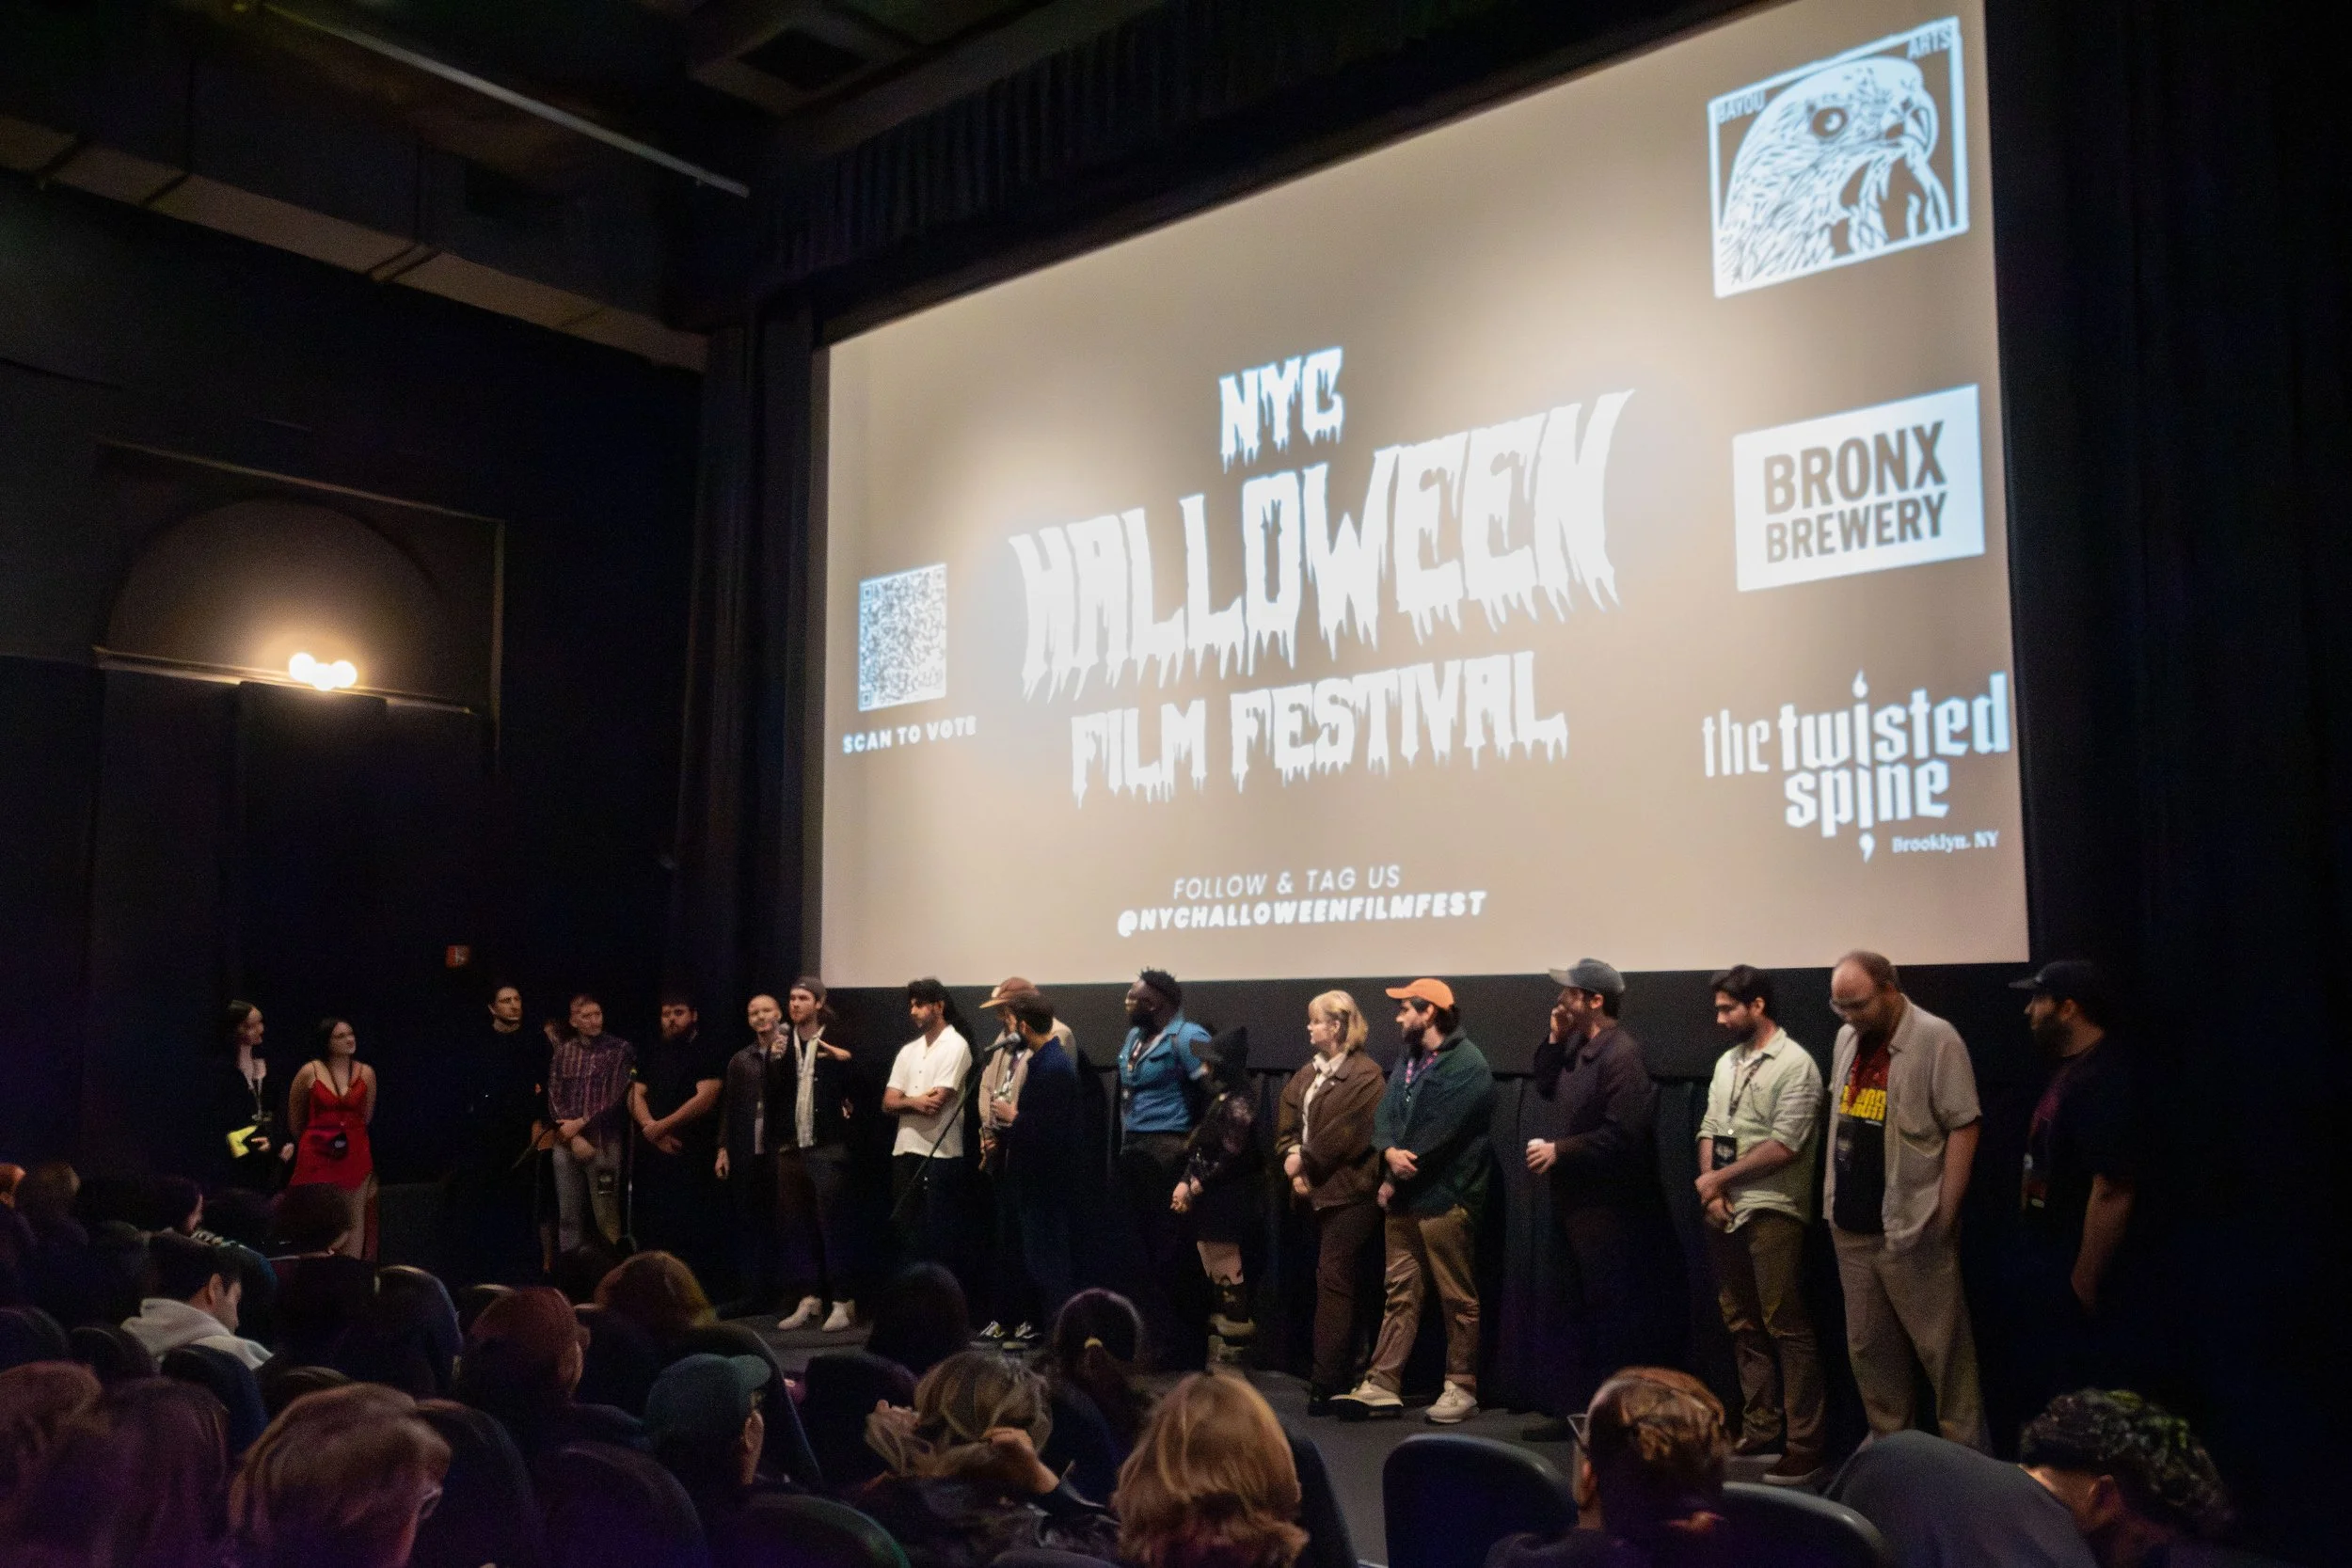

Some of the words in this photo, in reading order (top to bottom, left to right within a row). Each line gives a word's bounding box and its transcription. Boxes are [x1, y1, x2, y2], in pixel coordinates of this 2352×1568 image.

[1907, 26, 1952, 59] ARTS
[1219, 346, 1345, 473] NYC
[1763, 420, 1947, 515] BRONX
[1009, 388, 1636, 704] HALLOWEEN
[1765, 491, 1948, 563] BREWERY
[843, 729, 892, 754] SCAN
[897, 724, 921, 746] TO
[927, 715, 977, 741] VOTE
[1071, 699, 1208, 809] FILM
[1230, 650, 1569, 793] FESTIVAL
[1702, 708, 1771, 778] the
[1778, 669, 2010, 772] twisted
[1784, 758, 1950, 839] spine
[1974, 831, 1999, 849] NY
[1173, 874, 1267, 900] FOLLOW
[1276, 871, 1294, 895] &
[1307, 867, 1356, 892] TAG
[1368, 864, 1401, 890] US
